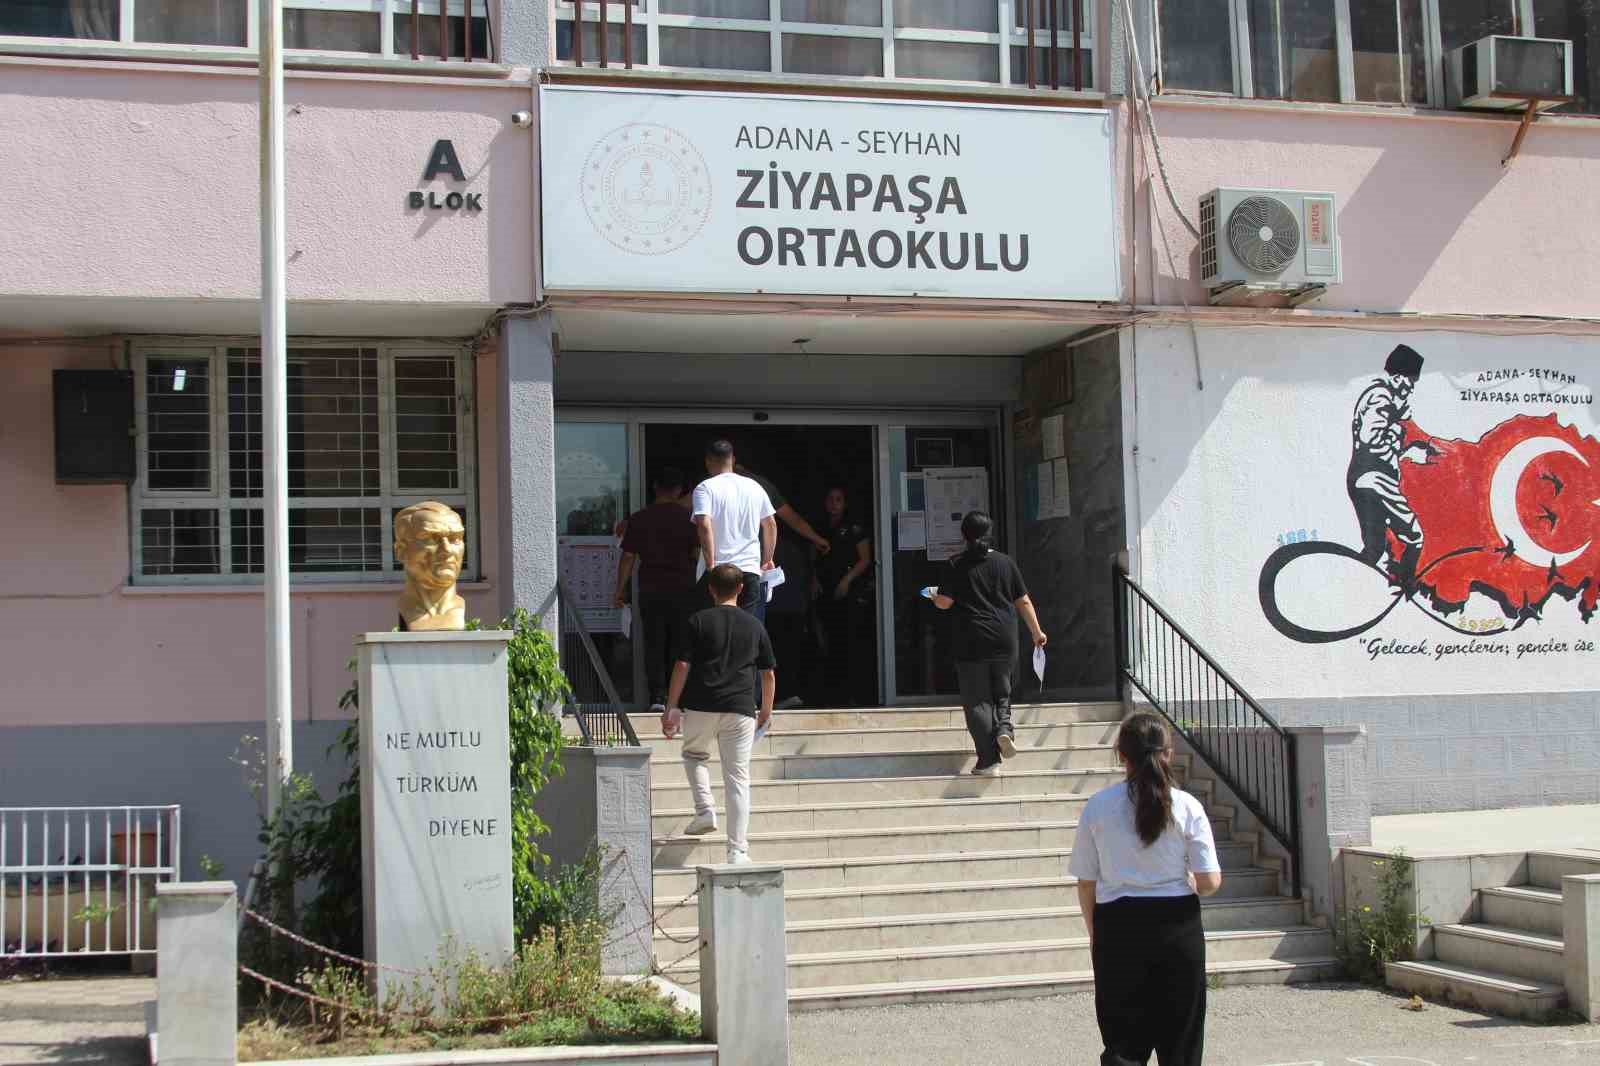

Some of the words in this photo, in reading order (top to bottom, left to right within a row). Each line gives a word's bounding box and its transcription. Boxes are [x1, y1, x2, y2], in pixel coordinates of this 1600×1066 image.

[736, 126, 833, 151] ADANA
[857, 131, 961, 156] SEYHAN
[424, 140, 466, 181] A
[409, 191, 483, 211] BLOK
[736, 160, 968, 224] ZİYAPAŞA
[737, 226, 1029, 273] ORTAOKULU
[1460, 388, 1520, 405] ZİYAPAŞA
[1523, 392, 1593, 405] ORTAOKULU
[1516, 637, 1568, 659] gençler
[1574, 639, 1595, 652] ise
[386, 732, 411, 750] NE
[416, 731, 481, 749] MUTLU
[396, 771, 478, 794] TÜRKÜM
[429, 817, 497, 837] DİYENE
